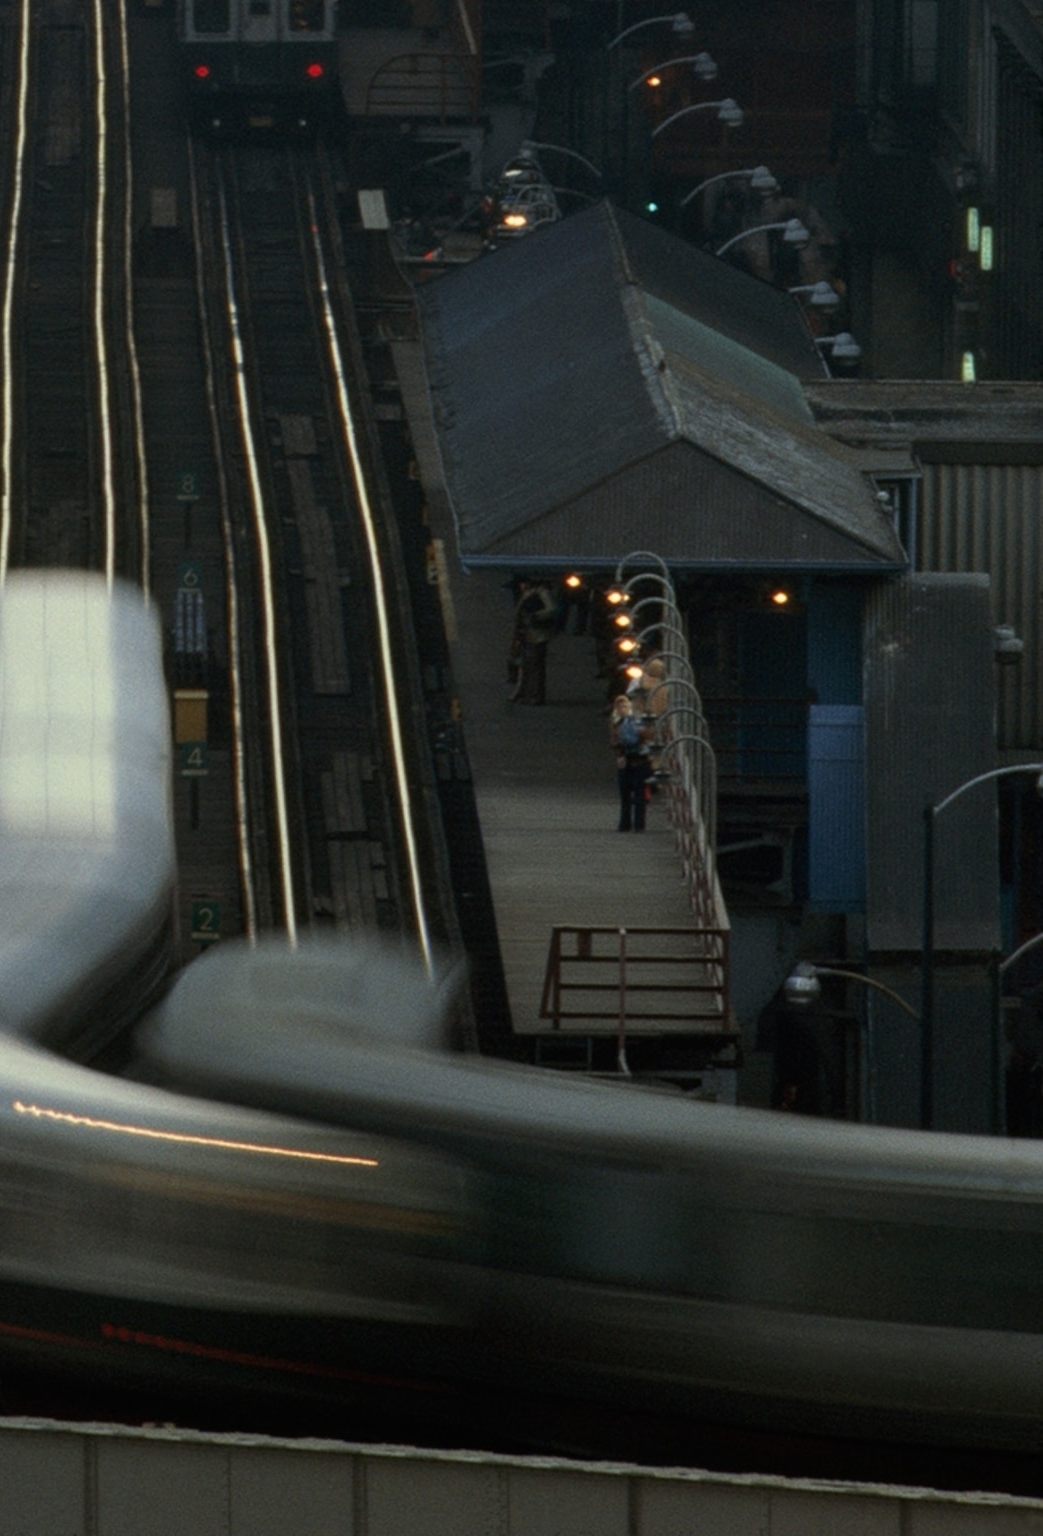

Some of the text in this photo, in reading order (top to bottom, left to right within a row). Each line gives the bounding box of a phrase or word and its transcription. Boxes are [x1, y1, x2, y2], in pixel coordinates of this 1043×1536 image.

[181, 474, 195, 493] 8
[182, 567, 198, 587] 6
[187, 746, 203, 767] 4
[197, 908, 214, 932] 2
